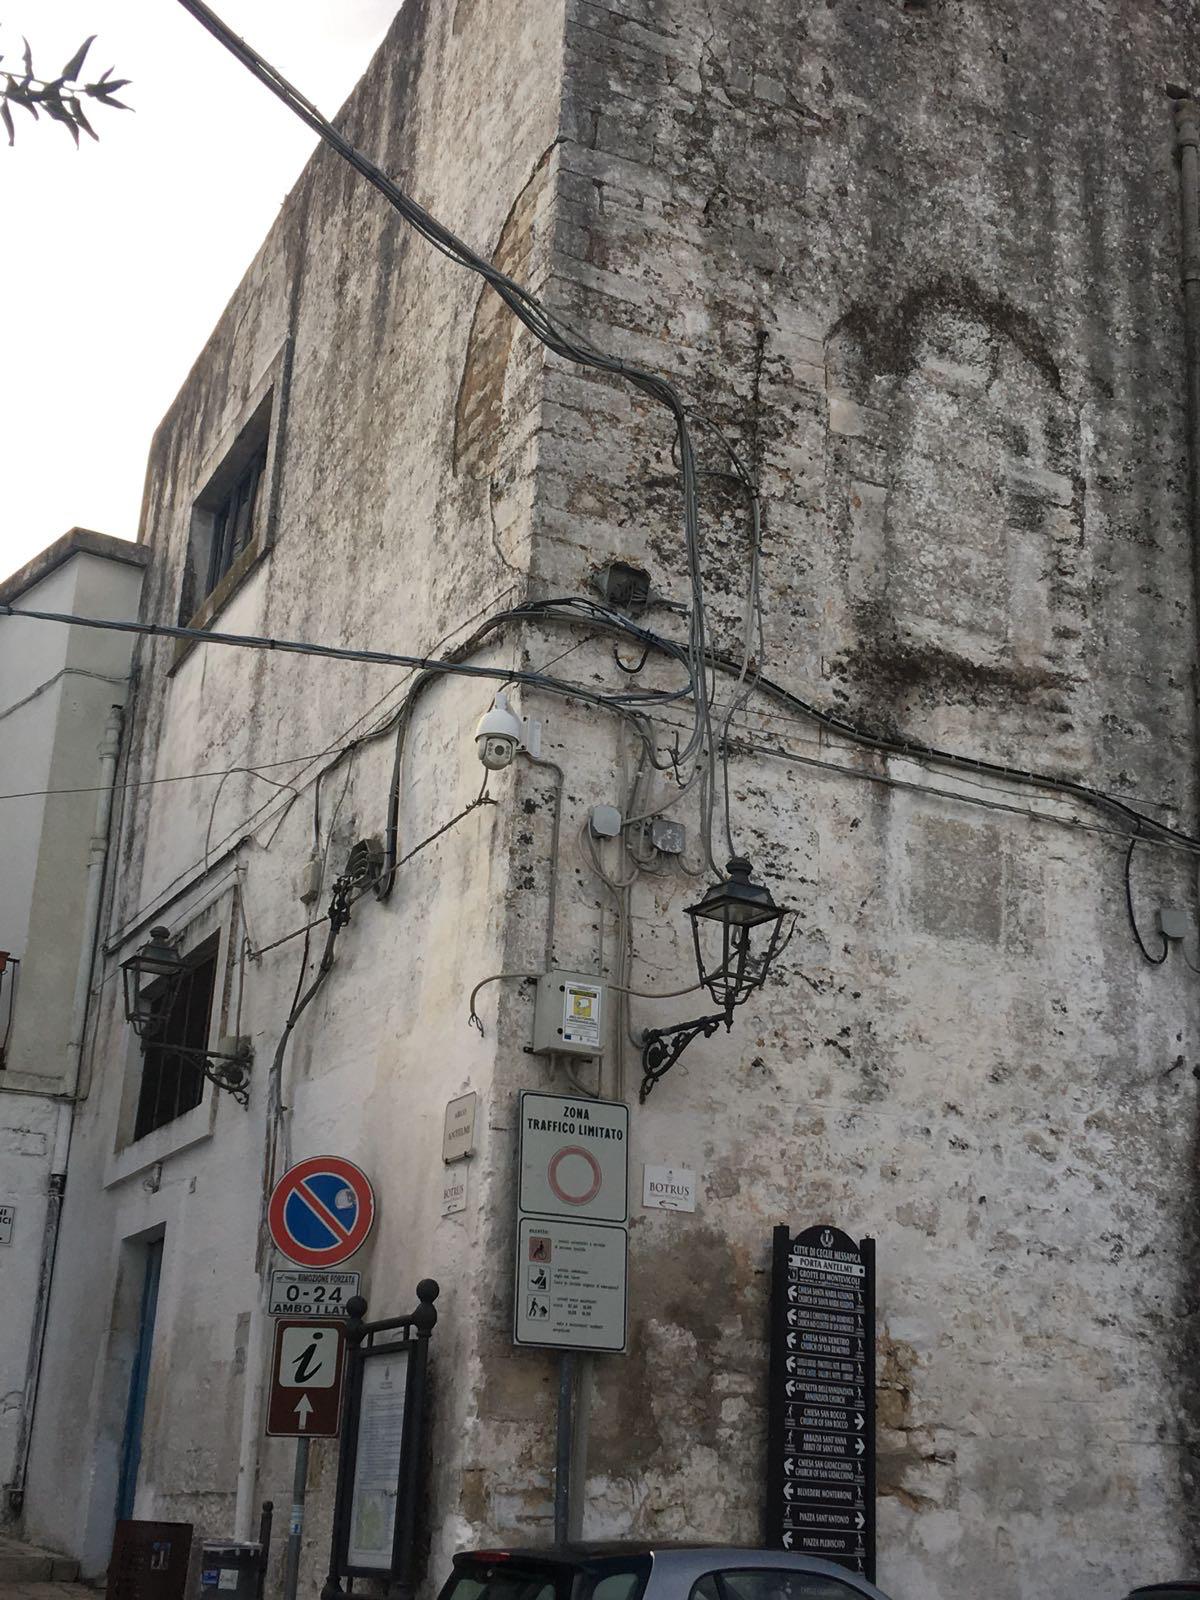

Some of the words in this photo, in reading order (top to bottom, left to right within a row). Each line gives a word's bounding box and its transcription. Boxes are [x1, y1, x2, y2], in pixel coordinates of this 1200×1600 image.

[564, 1106, 589, 1120] ZONA
[528, 1118, 575, 1134] TRAFFICO
[579, 1125, 623, 1140] LIMITATO
[650, 1182, 689, 1196] BOTRUS
[800, 1258, 821, 1268] PORTA
[800, 1269, 818, 1279] GROTTE
[286, 1285, 342, 1303] 0-24
[274, 1304, 311, 1313] AMBO
[316, 1305, 320, 1313] I
[325, 1306, 346, 1314] LAT
[803, 1333, 818, 1342] CHIESA
[830, 1411, 846, 1420] ROCCO
